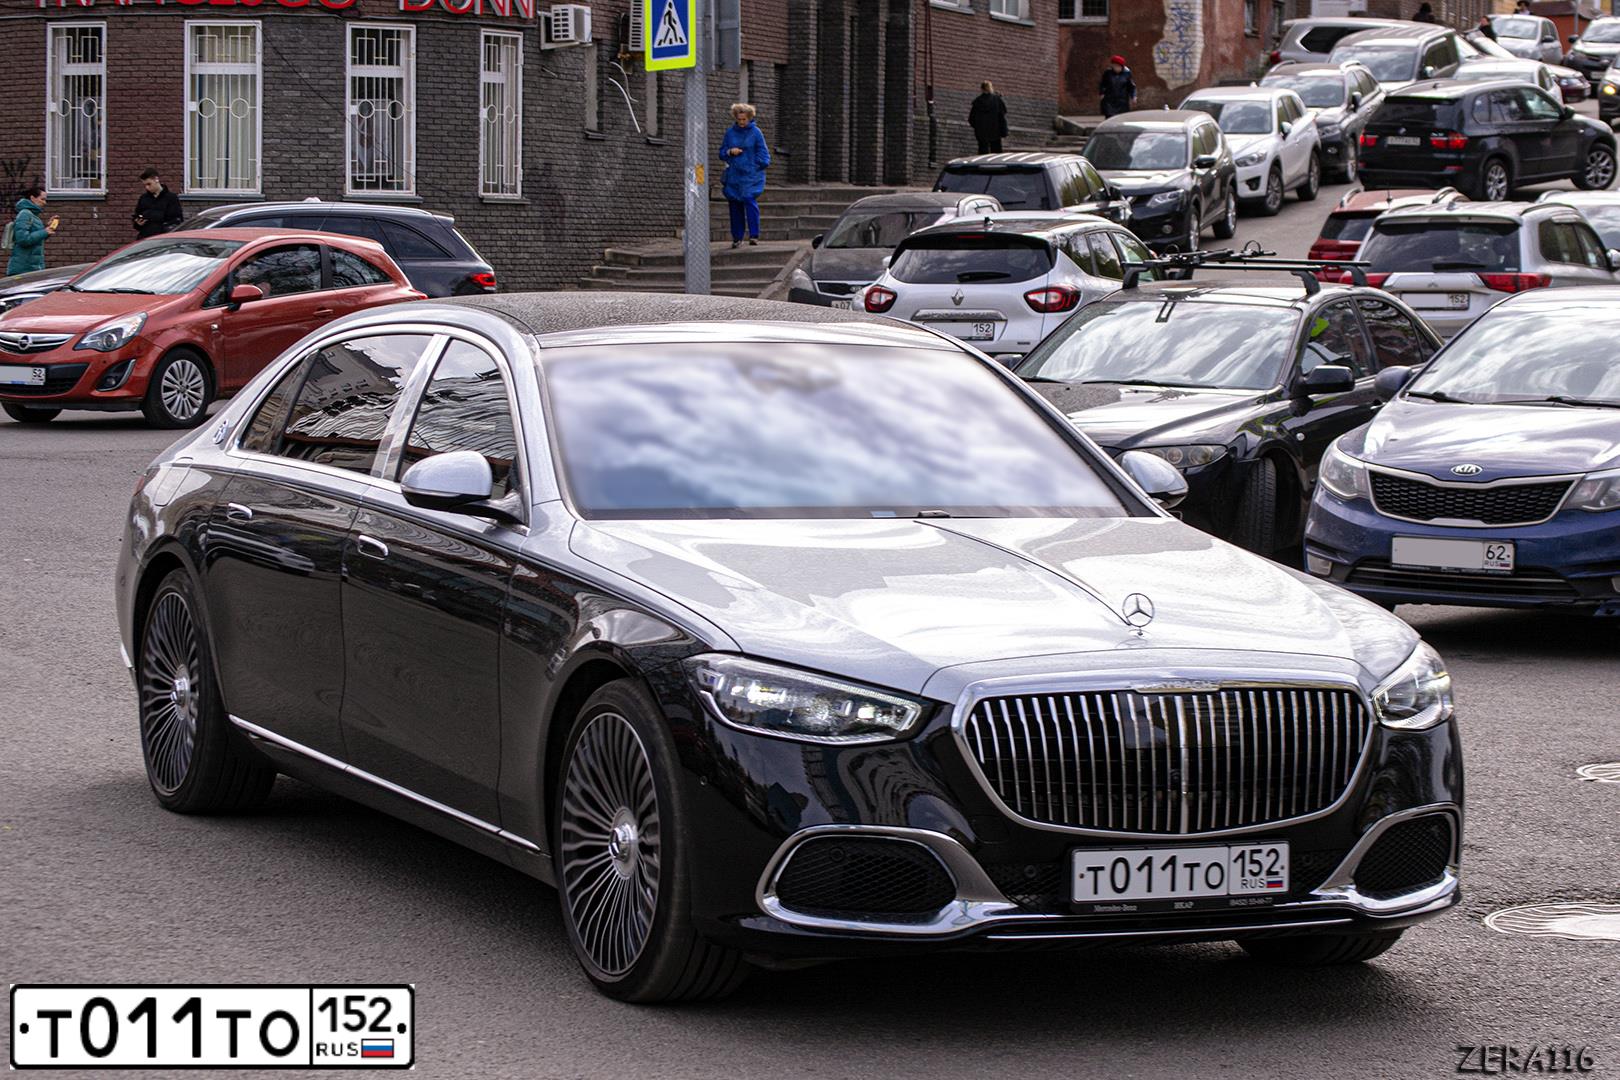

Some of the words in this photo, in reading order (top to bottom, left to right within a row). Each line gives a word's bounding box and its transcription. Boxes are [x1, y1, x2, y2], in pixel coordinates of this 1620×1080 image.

[973, 323, 991, 333] 152
[1486, 544, 1506, 561] 62
[1232, 848, 1280, 878] 152
[1240, 878, 1265, 889] RUS
